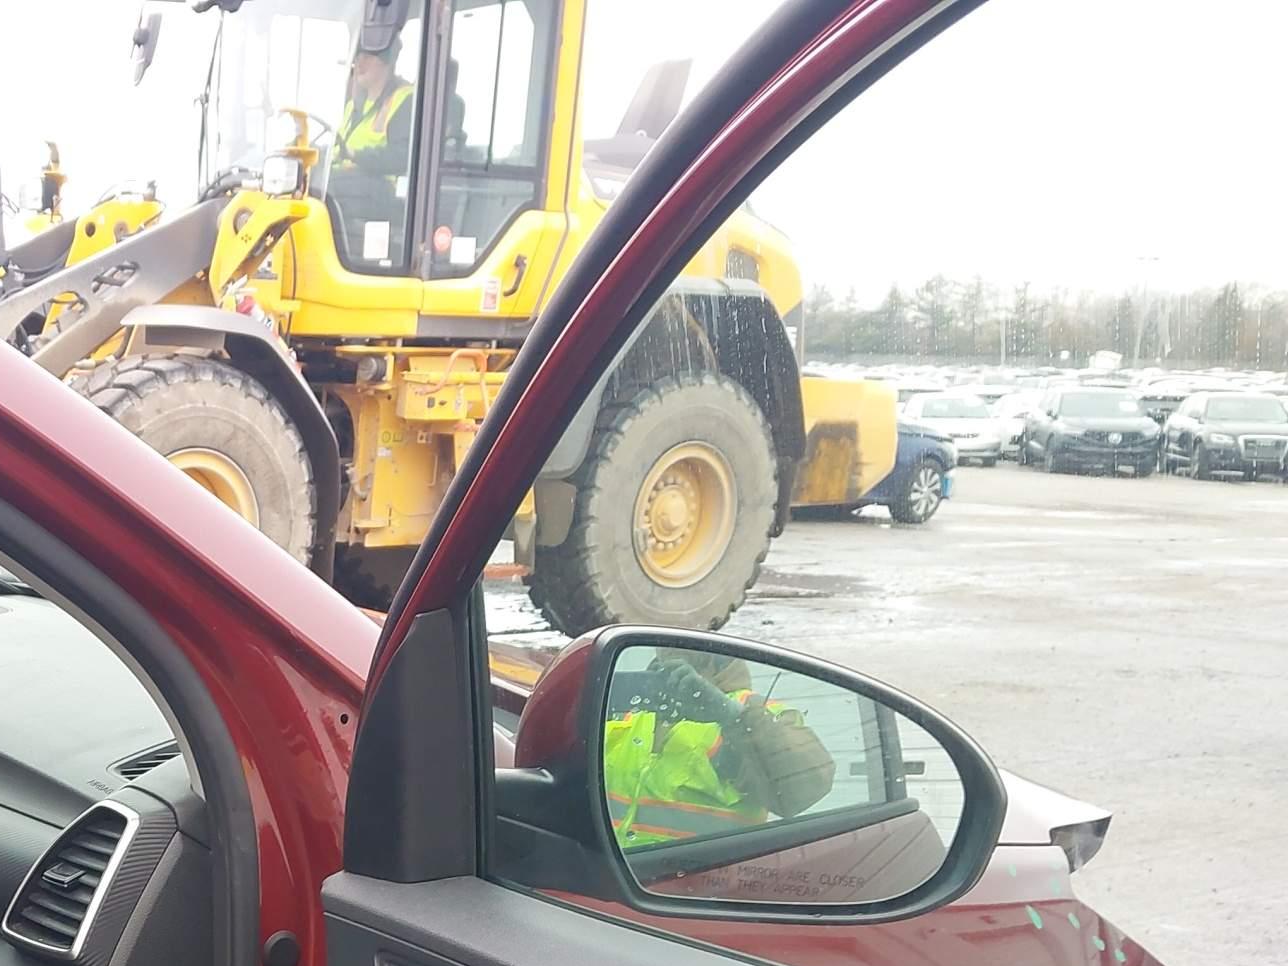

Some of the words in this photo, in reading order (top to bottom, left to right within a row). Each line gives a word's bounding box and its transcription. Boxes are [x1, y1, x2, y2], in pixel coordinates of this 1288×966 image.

[737, 865, 778, 880] MIRROR
[787, 870, 811, 883] ARE
[819, 873, 864, 888] CLOSER
[736, 878, 766, 892] THEY
[773, 884, 820, 896] APPEAR
